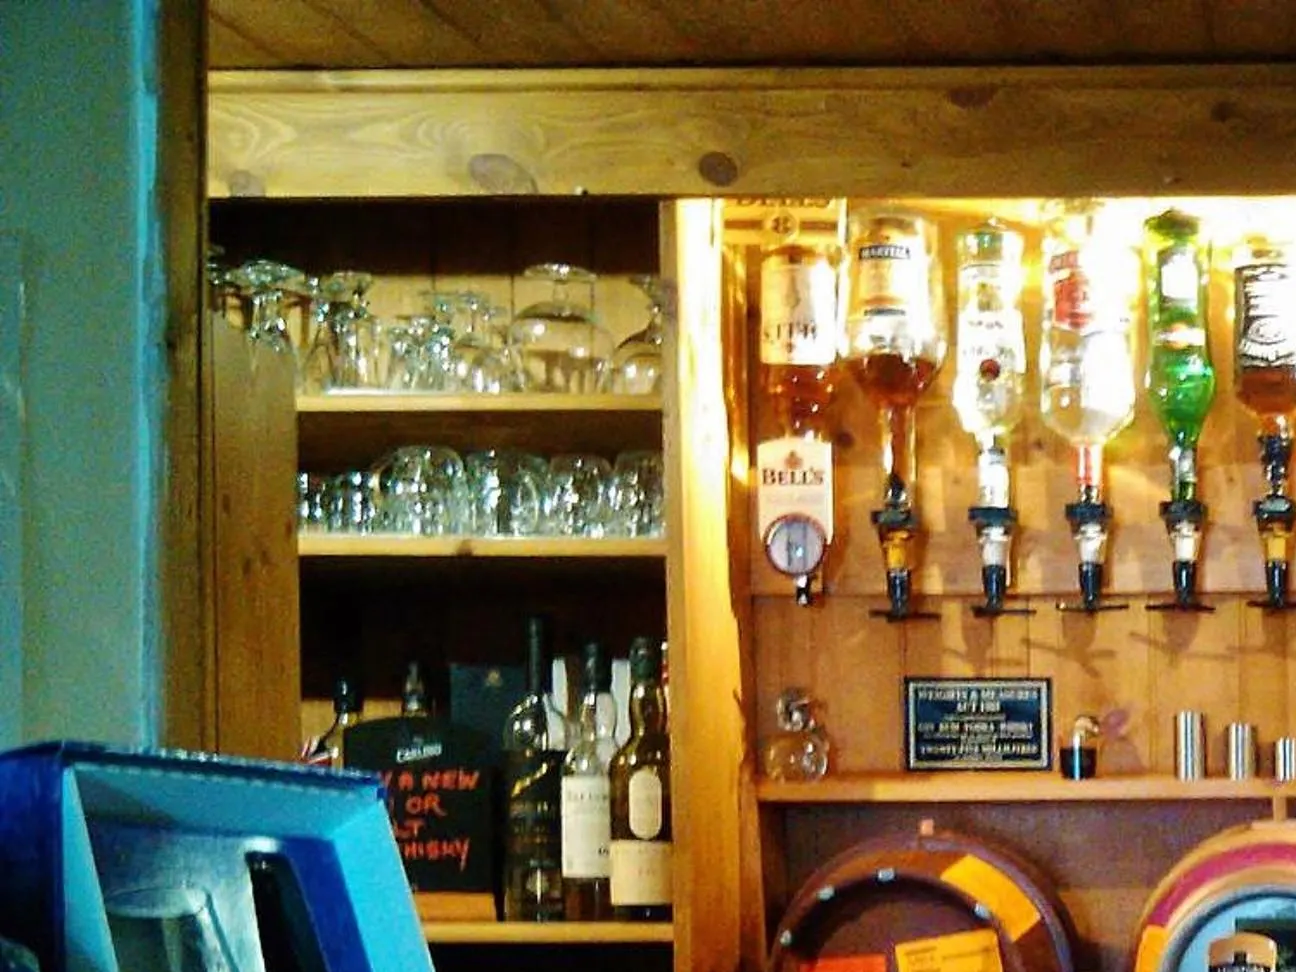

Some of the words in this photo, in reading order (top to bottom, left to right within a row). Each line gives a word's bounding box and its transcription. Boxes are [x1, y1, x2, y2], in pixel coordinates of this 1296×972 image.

[762, 467, 825, 486] BELL'S
[422, 769, 480, 791] NEW
[405, 792, 447, 816] OR
[393, 819, 426, 838] LT
[404, 836, 470, 872] HISKY
